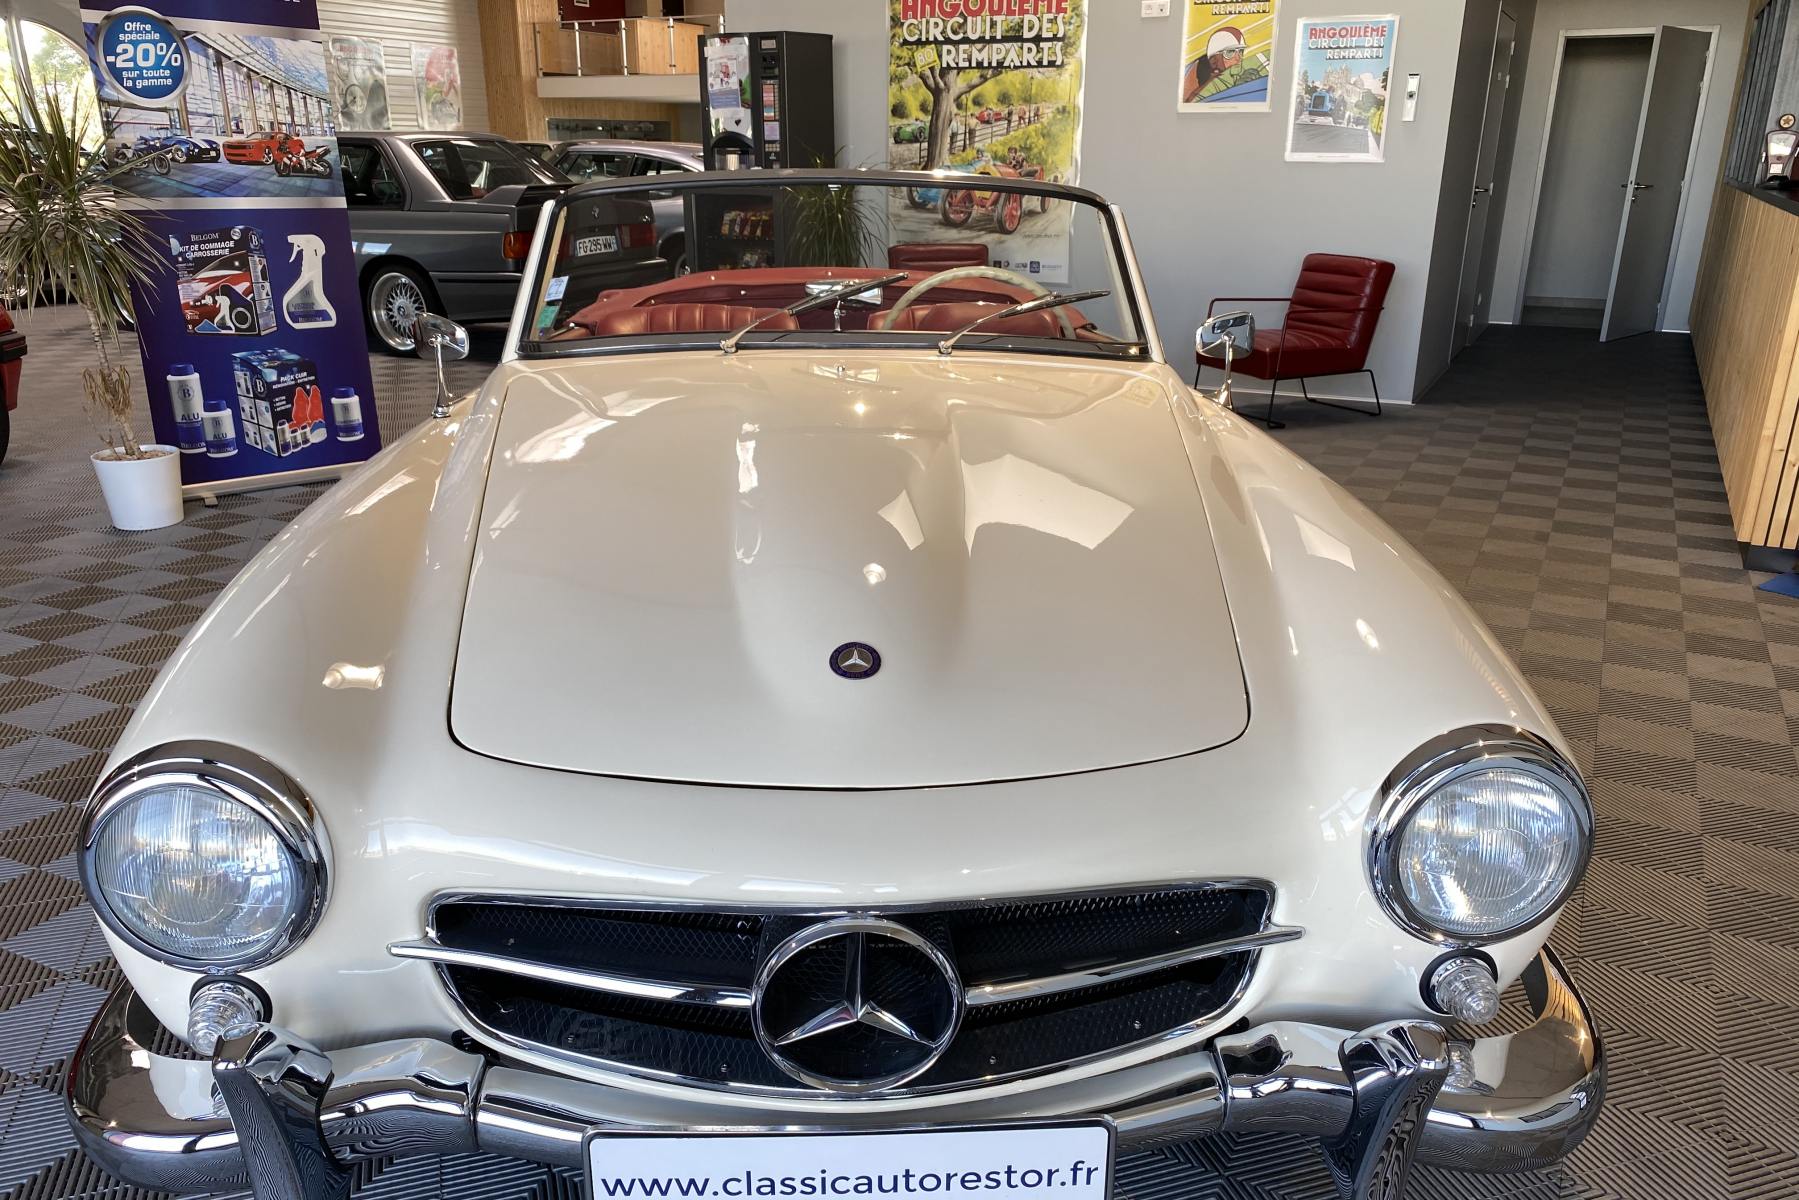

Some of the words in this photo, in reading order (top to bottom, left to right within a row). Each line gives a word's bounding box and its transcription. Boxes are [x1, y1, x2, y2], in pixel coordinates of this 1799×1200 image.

[124, 22, 152, 31] Offre
[902, 15, 1006, 42] CIRCUIT
[1023, 13, 1065, 39] DES
[1309, 23, 1387, 39] ANGOULÊME
[118, 31, 160, 42] spéciale
[1308, 37, 1357, 49] CIRCUIT
[106, 42, 181, 68] -20%
[941, 41, 1064, 68] REMPARTS
[122, 70, 140, 78] sur
[142, 69, 171, 77] toute
[123, 78, 133, 87] la
[135, 78, 173, 89] gamme
[191, 232, 220, 242] BELGOM
[190, 244, 200, 252] DE
[199, 240, 235, 251] GOMMAGE
[185, 248, 230, 259] CARROSSERIE
[181, 412, 200, 422] ALU
[212, 432, 228, 440] ALU
[600, 1159, 1099, 1197] www.classicautorestor.fr
